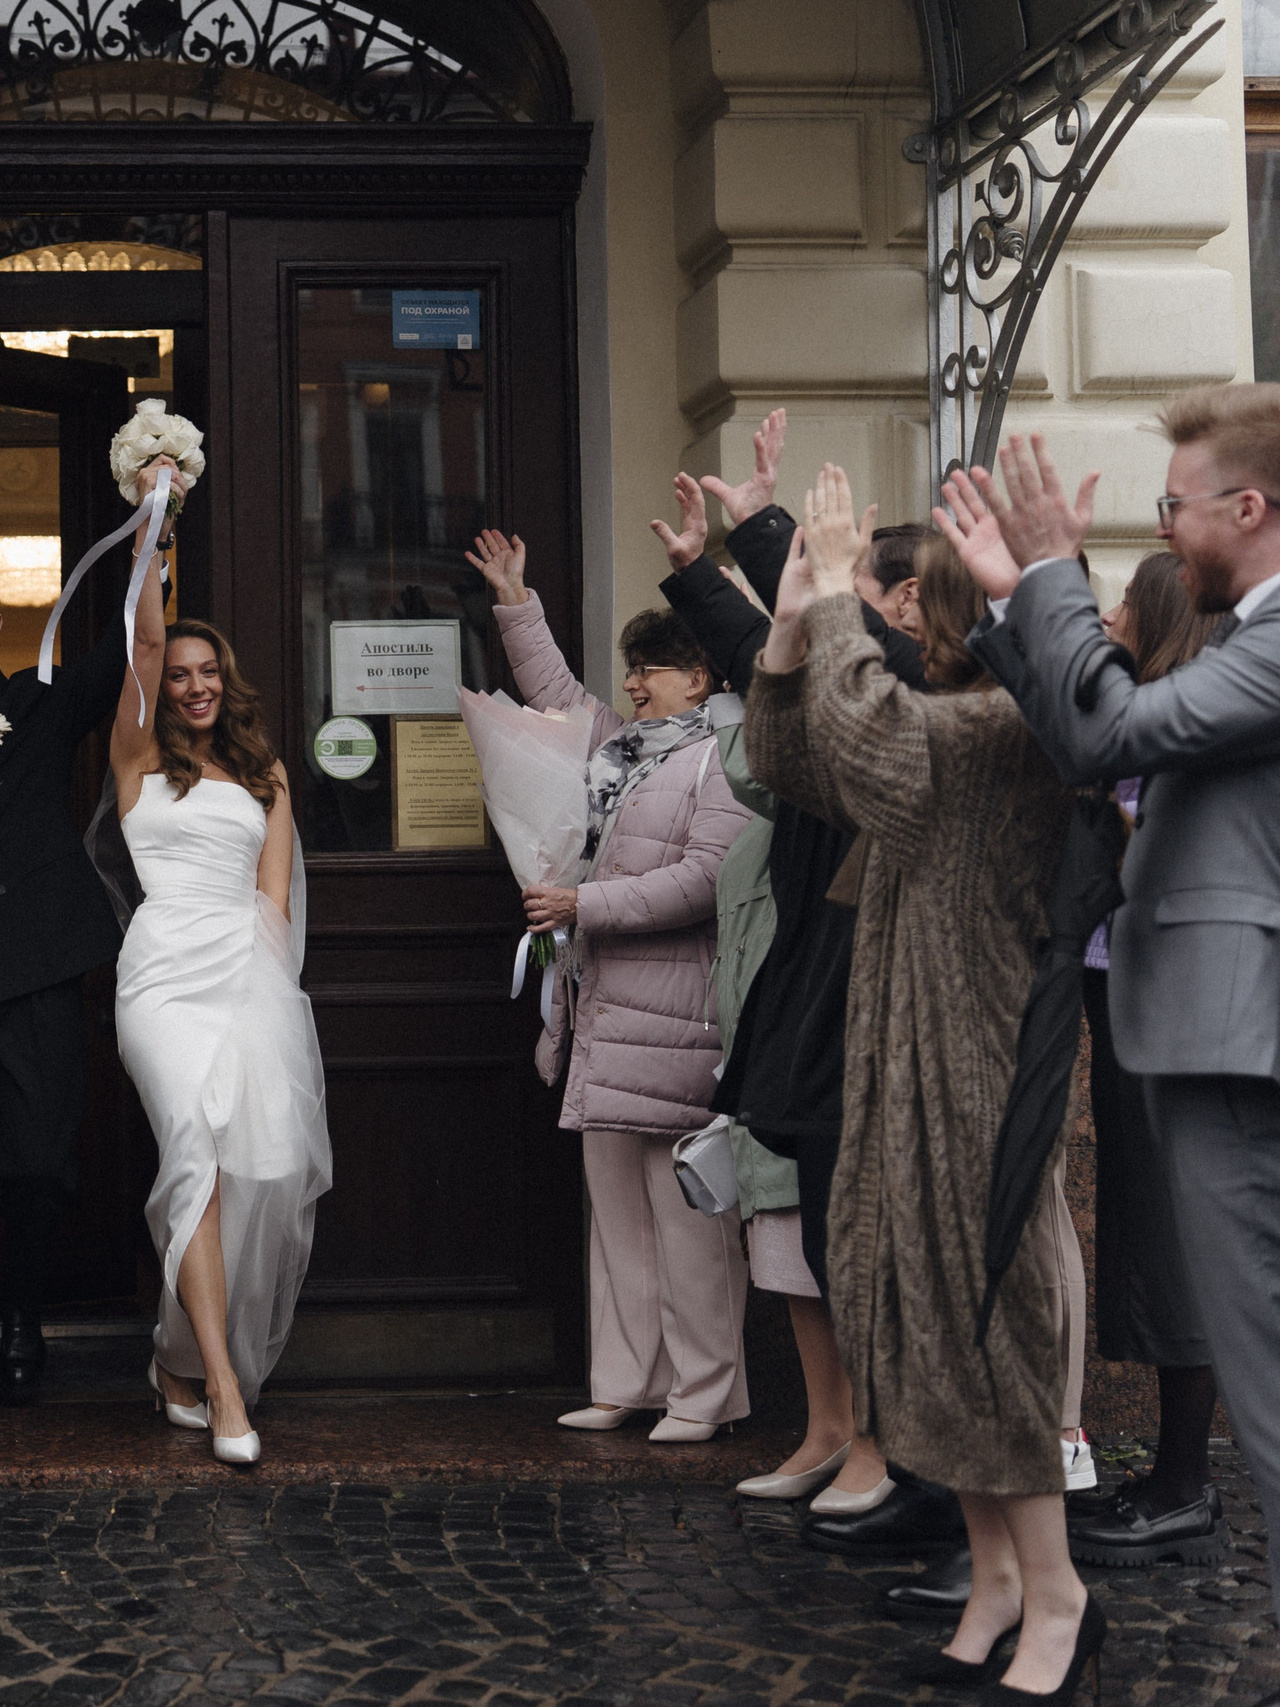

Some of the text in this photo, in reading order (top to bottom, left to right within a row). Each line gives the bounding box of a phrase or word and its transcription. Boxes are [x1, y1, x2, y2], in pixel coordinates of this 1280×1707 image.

[401, 305, 470, 315] ПОД ОХРАНОЙ
[361, 642, 433, 655] Апостиль
[366, 665, 430, 679] во дворе
[321, 720, 370, 738] УЧАСТНИК ПРОЕКТА
